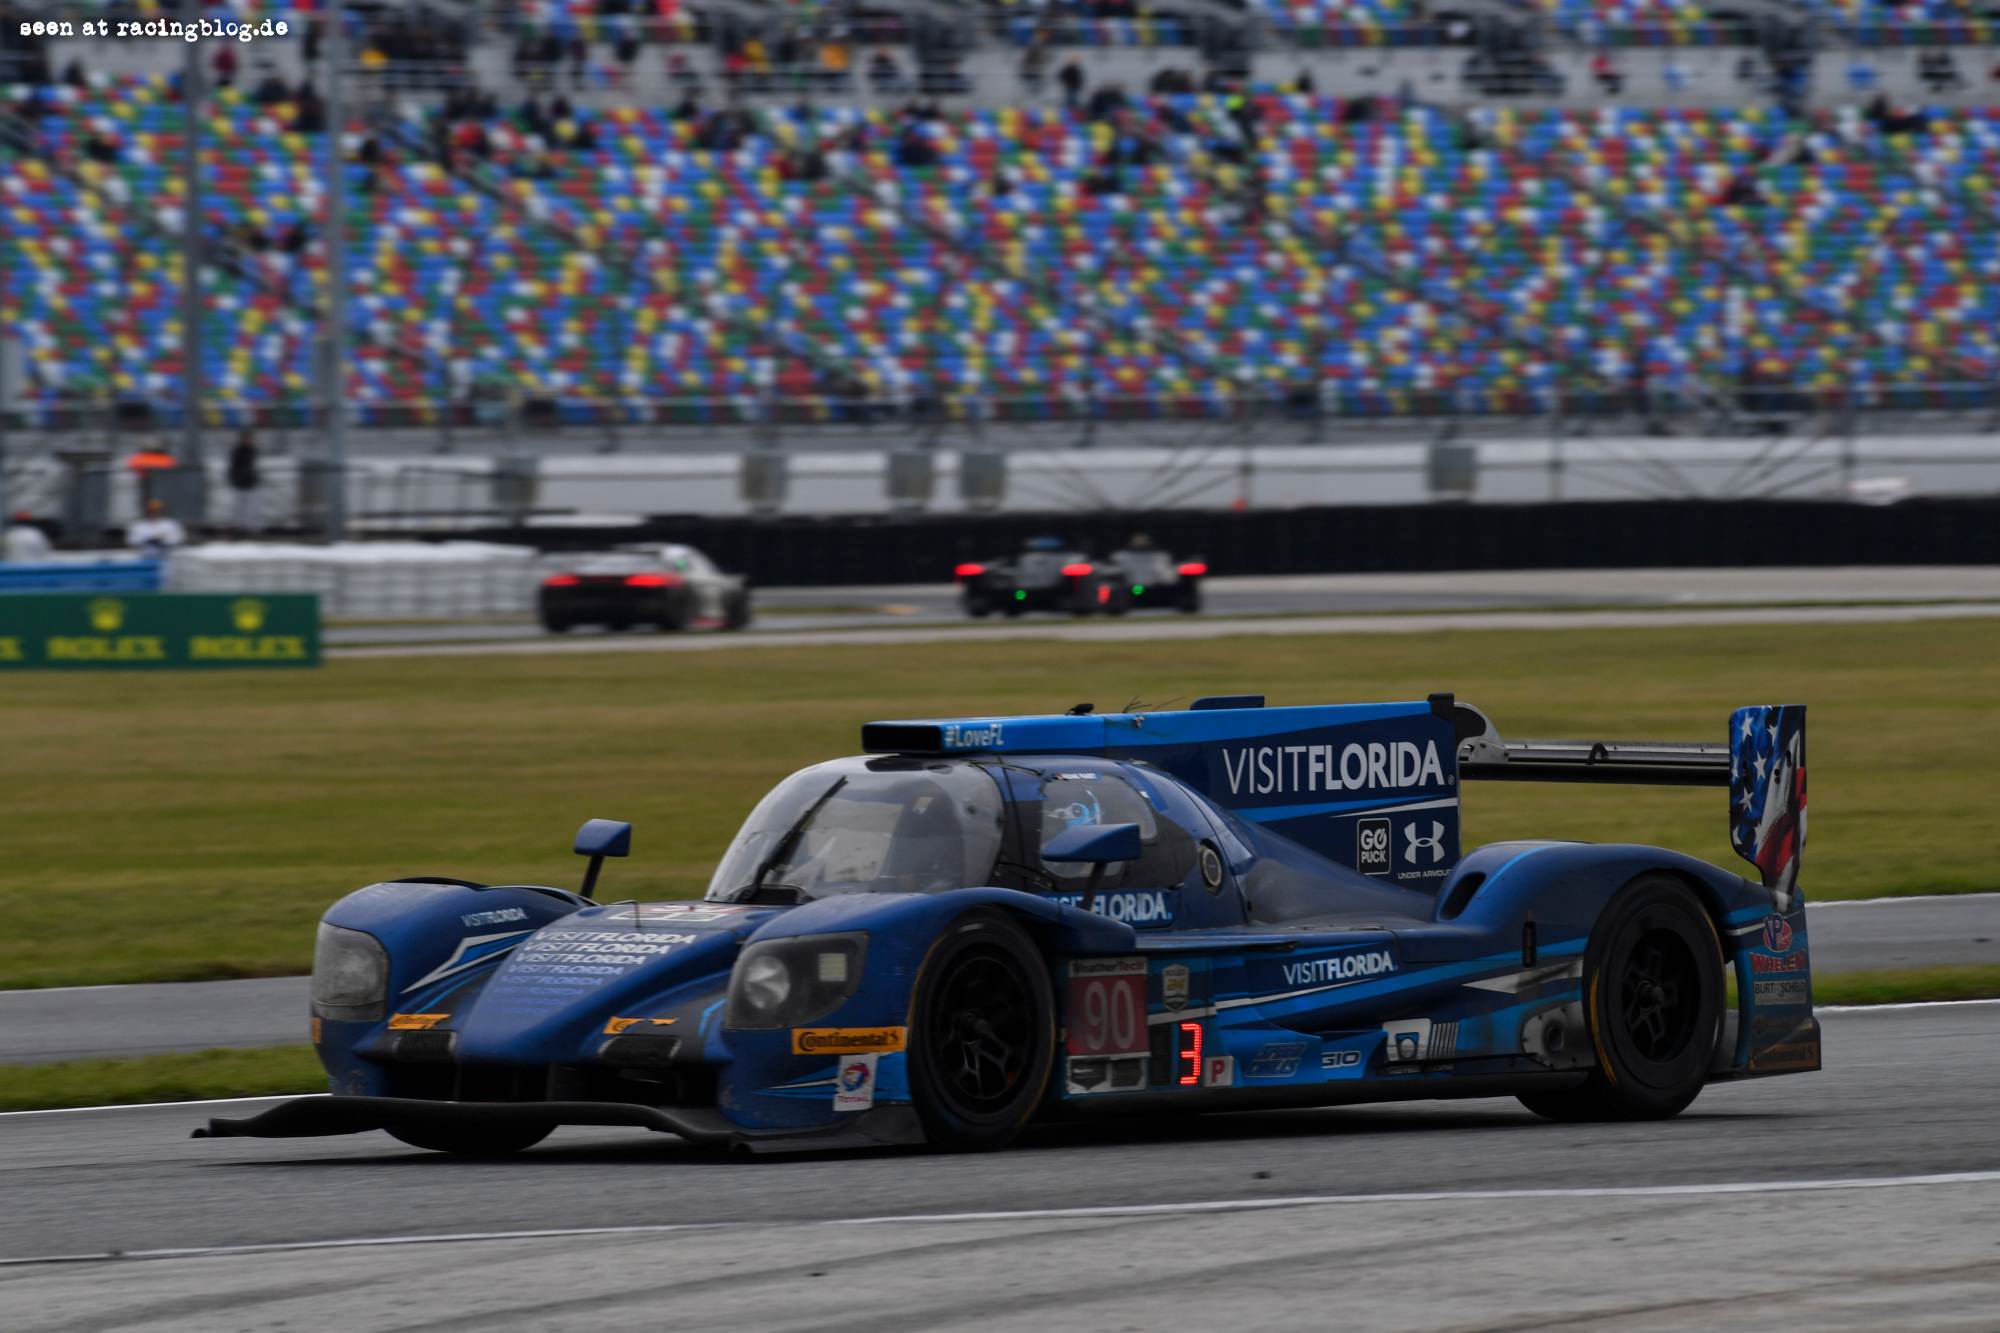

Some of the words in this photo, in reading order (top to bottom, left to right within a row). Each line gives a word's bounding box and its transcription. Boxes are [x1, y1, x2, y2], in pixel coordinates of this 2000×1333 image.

[944, 723, 1005, 748] #LoveFL
[1222, 739, 1446, 795] VISITFLORIDA
[1360, 827, 1387, 851] GO
[1360, 850, 1387, 864] PUCK
[1397, 871, 1421, 880] UNDER
[523, 942, 671, 955] VISITFLORIDA
[533, 931, 697, 944] VISITFLORIDA
[515, 953, 647, 965] VISITFLORIDA
[1283, 951, 1393, 985] VISITFLORIDA
[1084, 979, 1136, 1051] 90
[799, 1031, 887, 1051] Continental
[1180, 1022, 1203, 1086] 3
[1211, 1060, 1226, 1083] P
